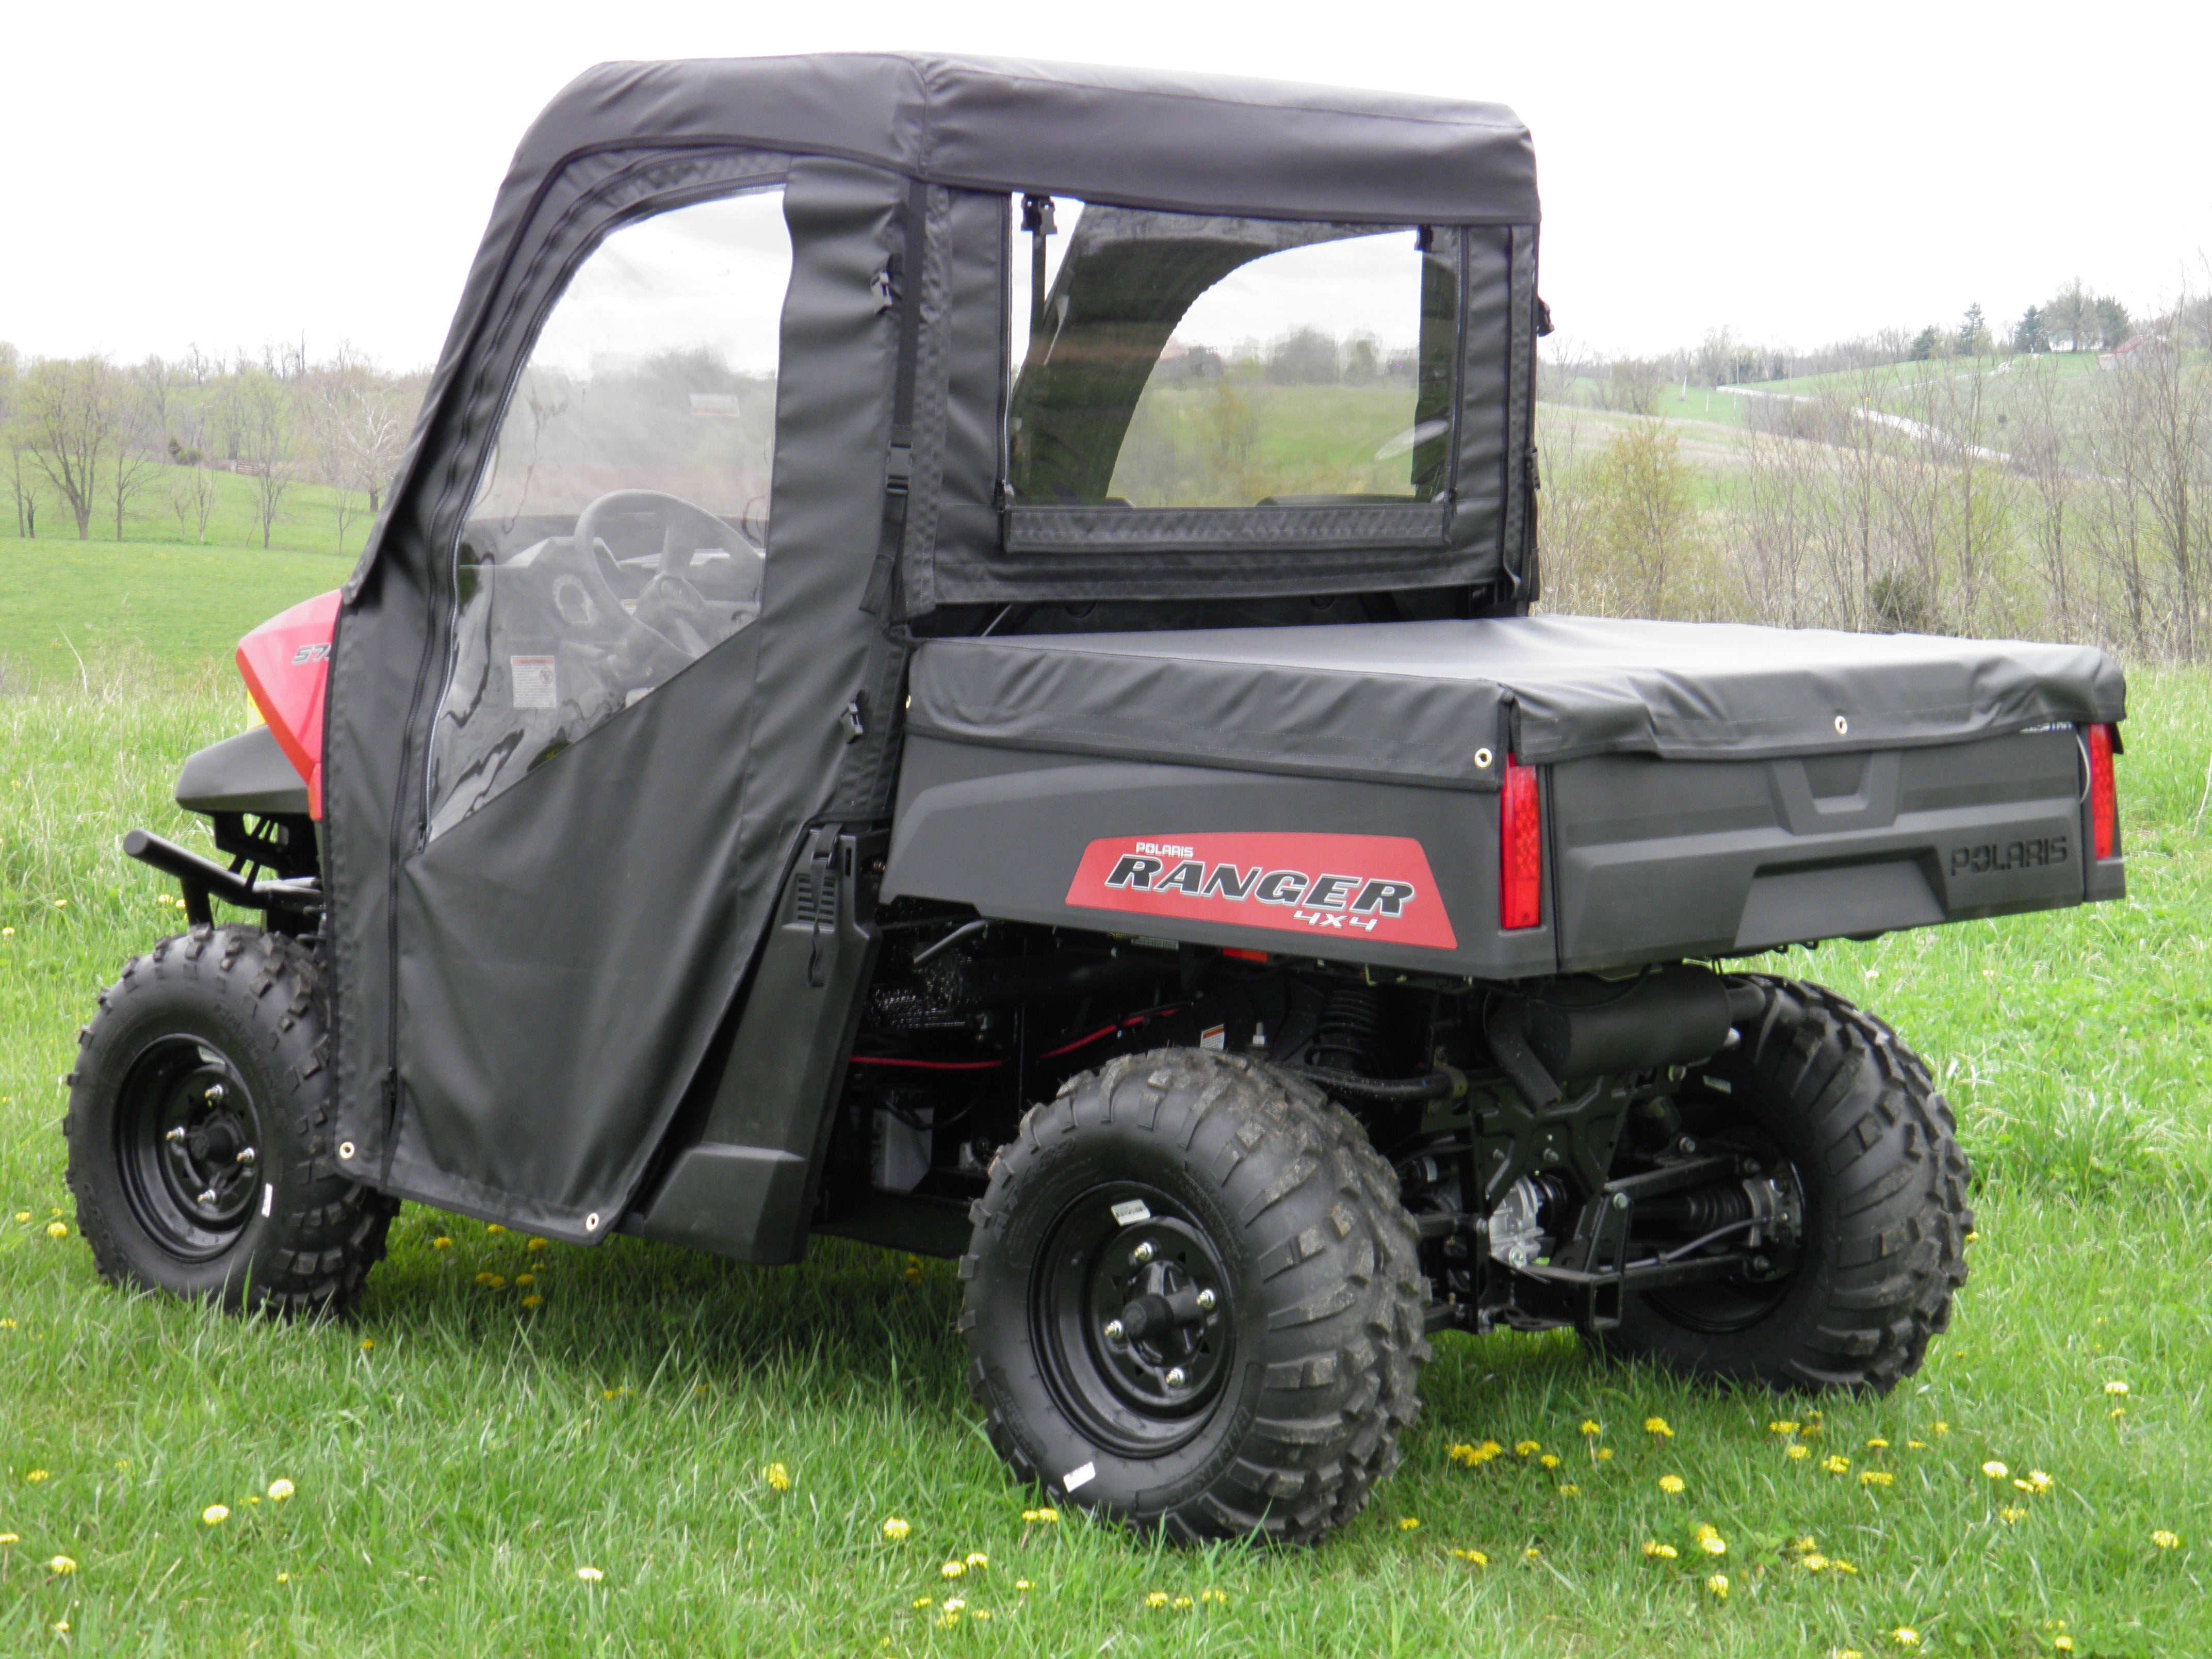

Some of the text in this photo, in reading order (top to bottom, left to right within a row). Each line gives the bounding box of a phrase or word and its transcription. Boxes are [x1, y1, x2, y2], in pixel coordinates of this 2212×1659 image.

[291, 643, 331, 665] 57
[1136, 842, 1193, 858] POLARIS
[1950, 835, 2068, 876] POLARIS
[1104, 854, 1416, 919] RANGER
